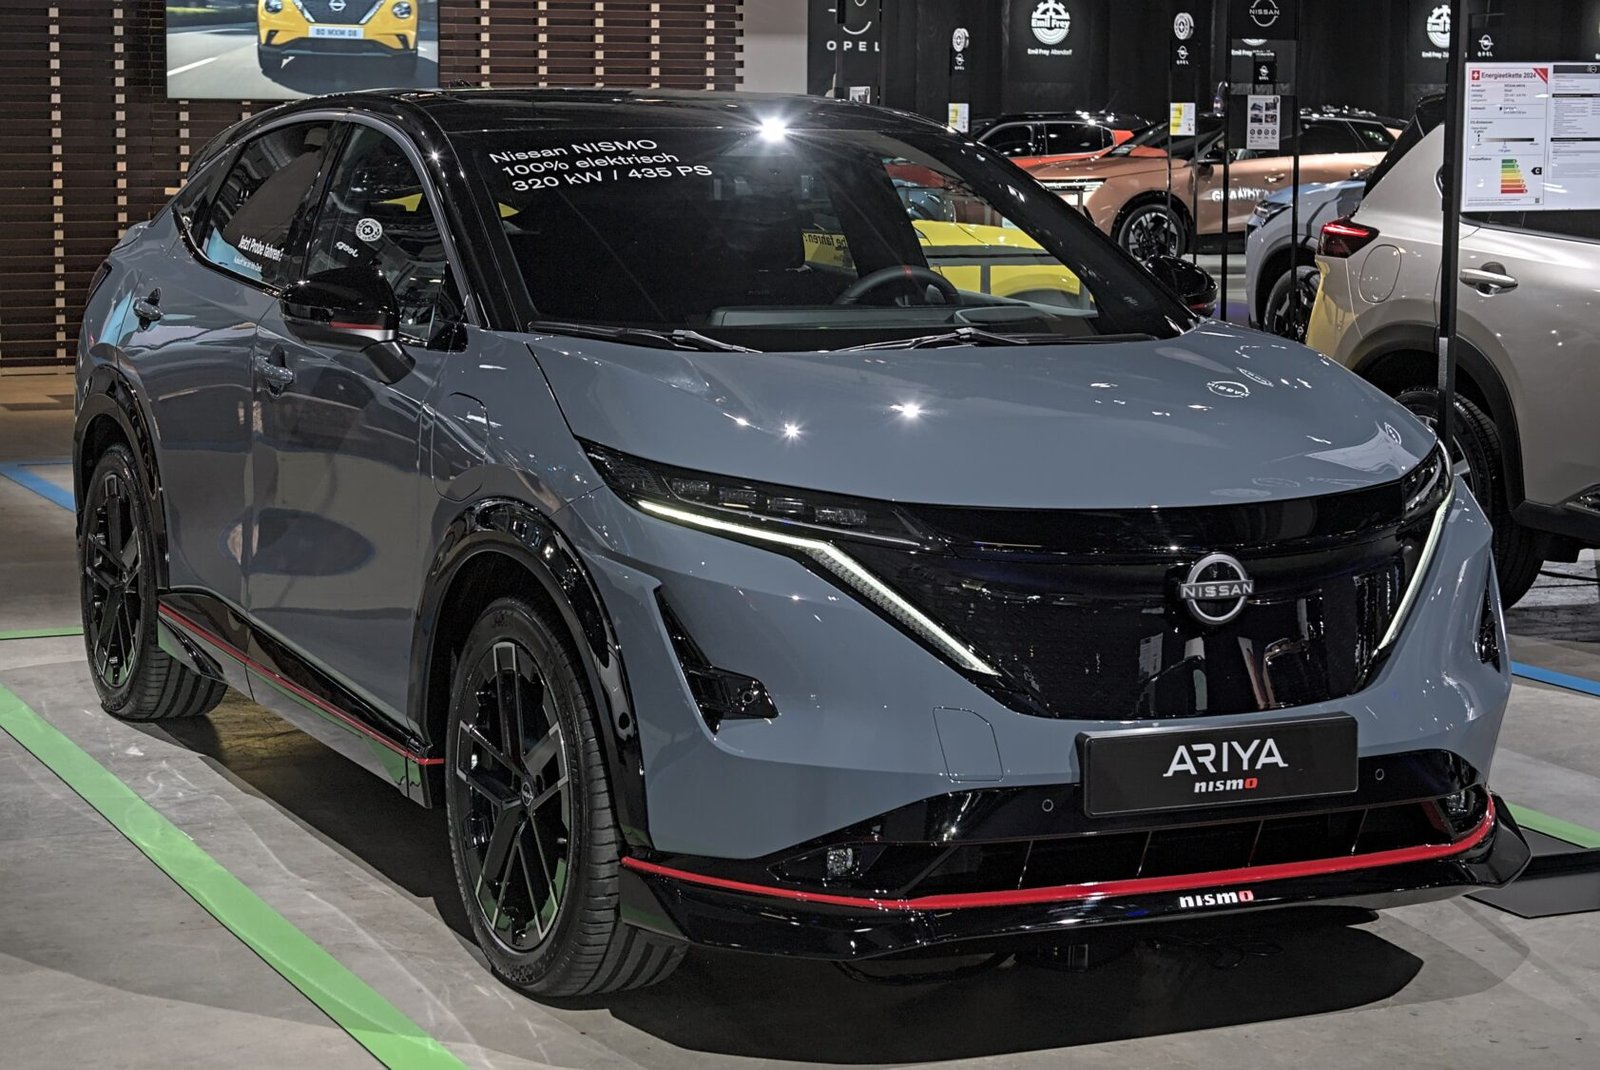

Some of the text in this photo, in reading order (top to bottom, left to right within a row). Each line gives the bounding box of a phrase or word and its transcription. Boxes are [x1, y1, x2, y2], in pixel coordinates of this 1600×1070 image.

[1031, 18, 1071, 30] Emil Frey
[826, 40, 880, 52] OPEL
[1481, 71, 1522, 79] Energieetikette
[489, 139, 658, 163] Nissan NISMO
[502, 152, 680, 176] 100% elektrisch
[512, 176, 559, 191] 320
[563, 170, 603, 185] kW
[628, 167, 672, 179] 435
[676, 165, 713, 177] PS
[1182, 582, 1253, 598] NISSAN
[1163, 738, 1288, 777] ARIYA
[1194, 777, 1258, 793] nismo
[1179, 890, 1254, 908] nismo
